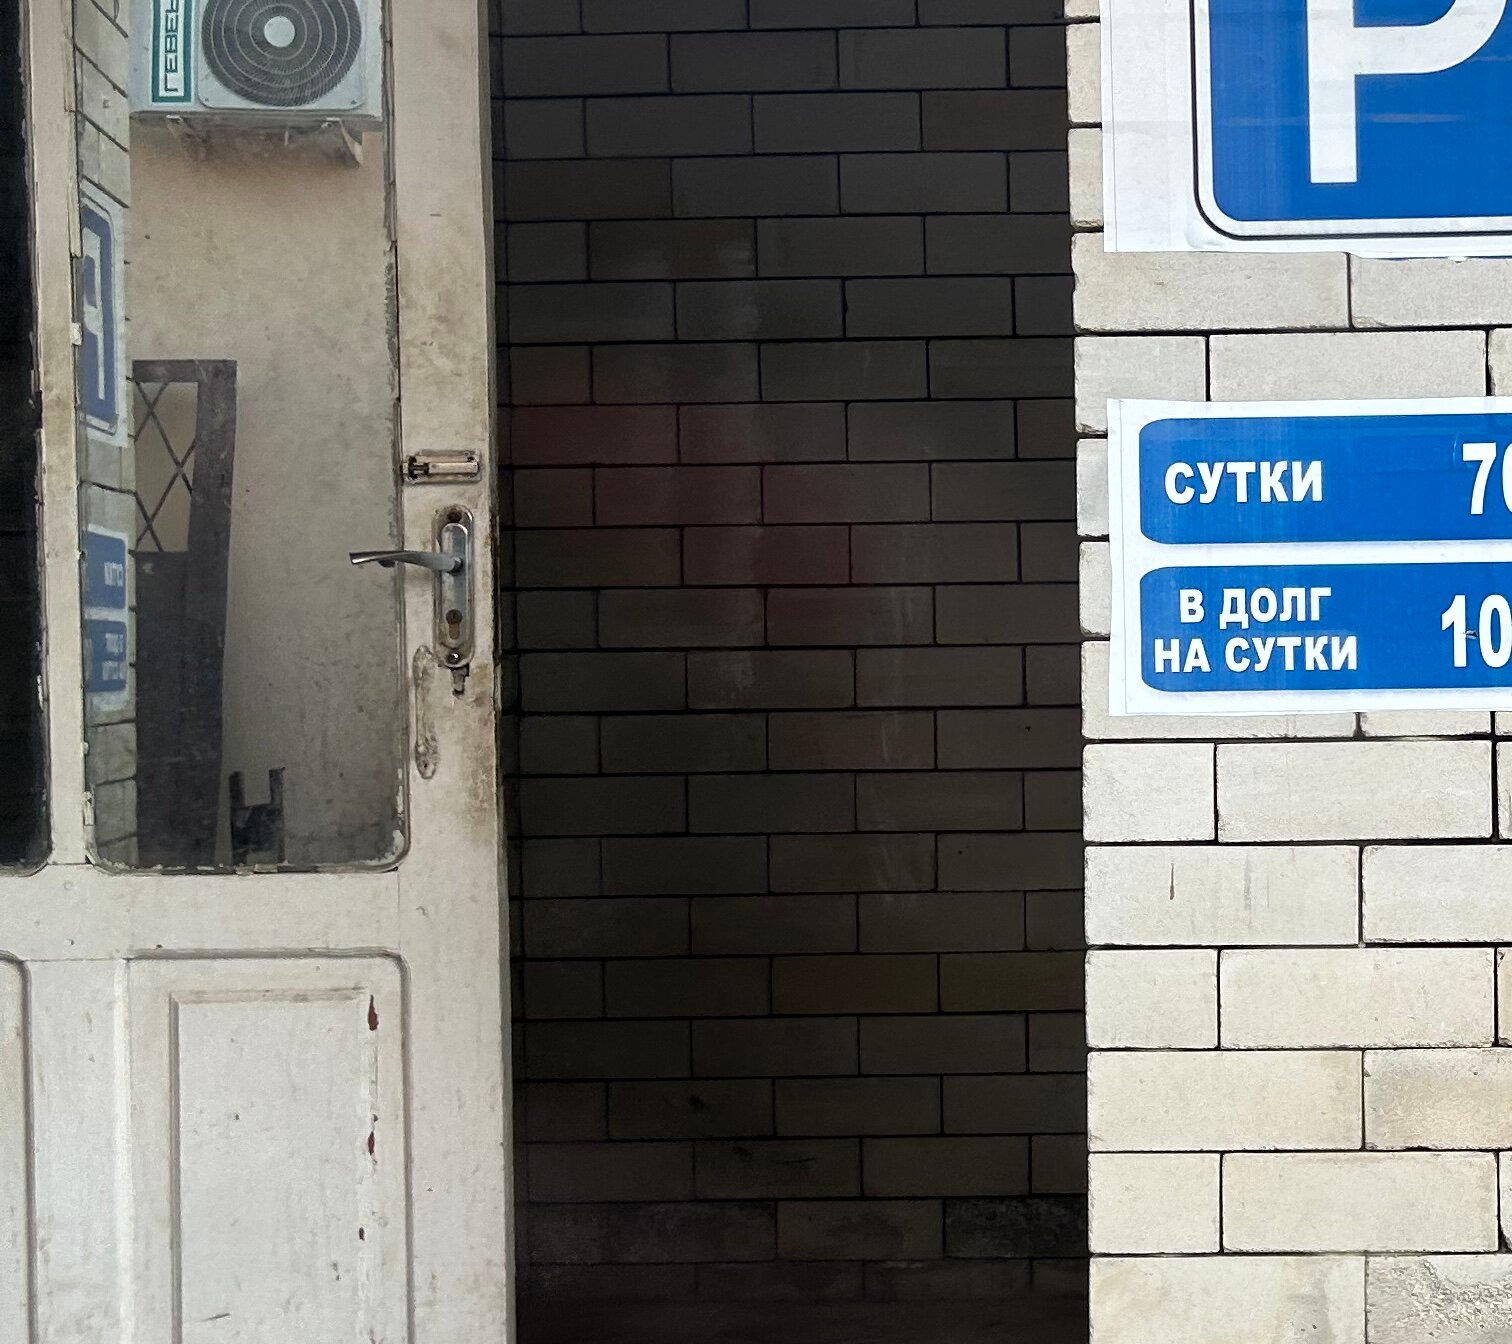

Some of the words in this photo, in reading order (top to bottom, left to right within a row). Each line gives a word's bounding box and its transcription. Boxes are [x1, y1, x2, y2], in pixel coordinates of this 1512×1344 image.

[1165, 461, 1322, 503] СУТКИ
[1180, 589, 1204, 622] В
[1220, 588, 1331, 629] ДОЛГ
[1155, 639, 1210, 672] НА
[1226, 636, 1356, 671] СУТКИ
